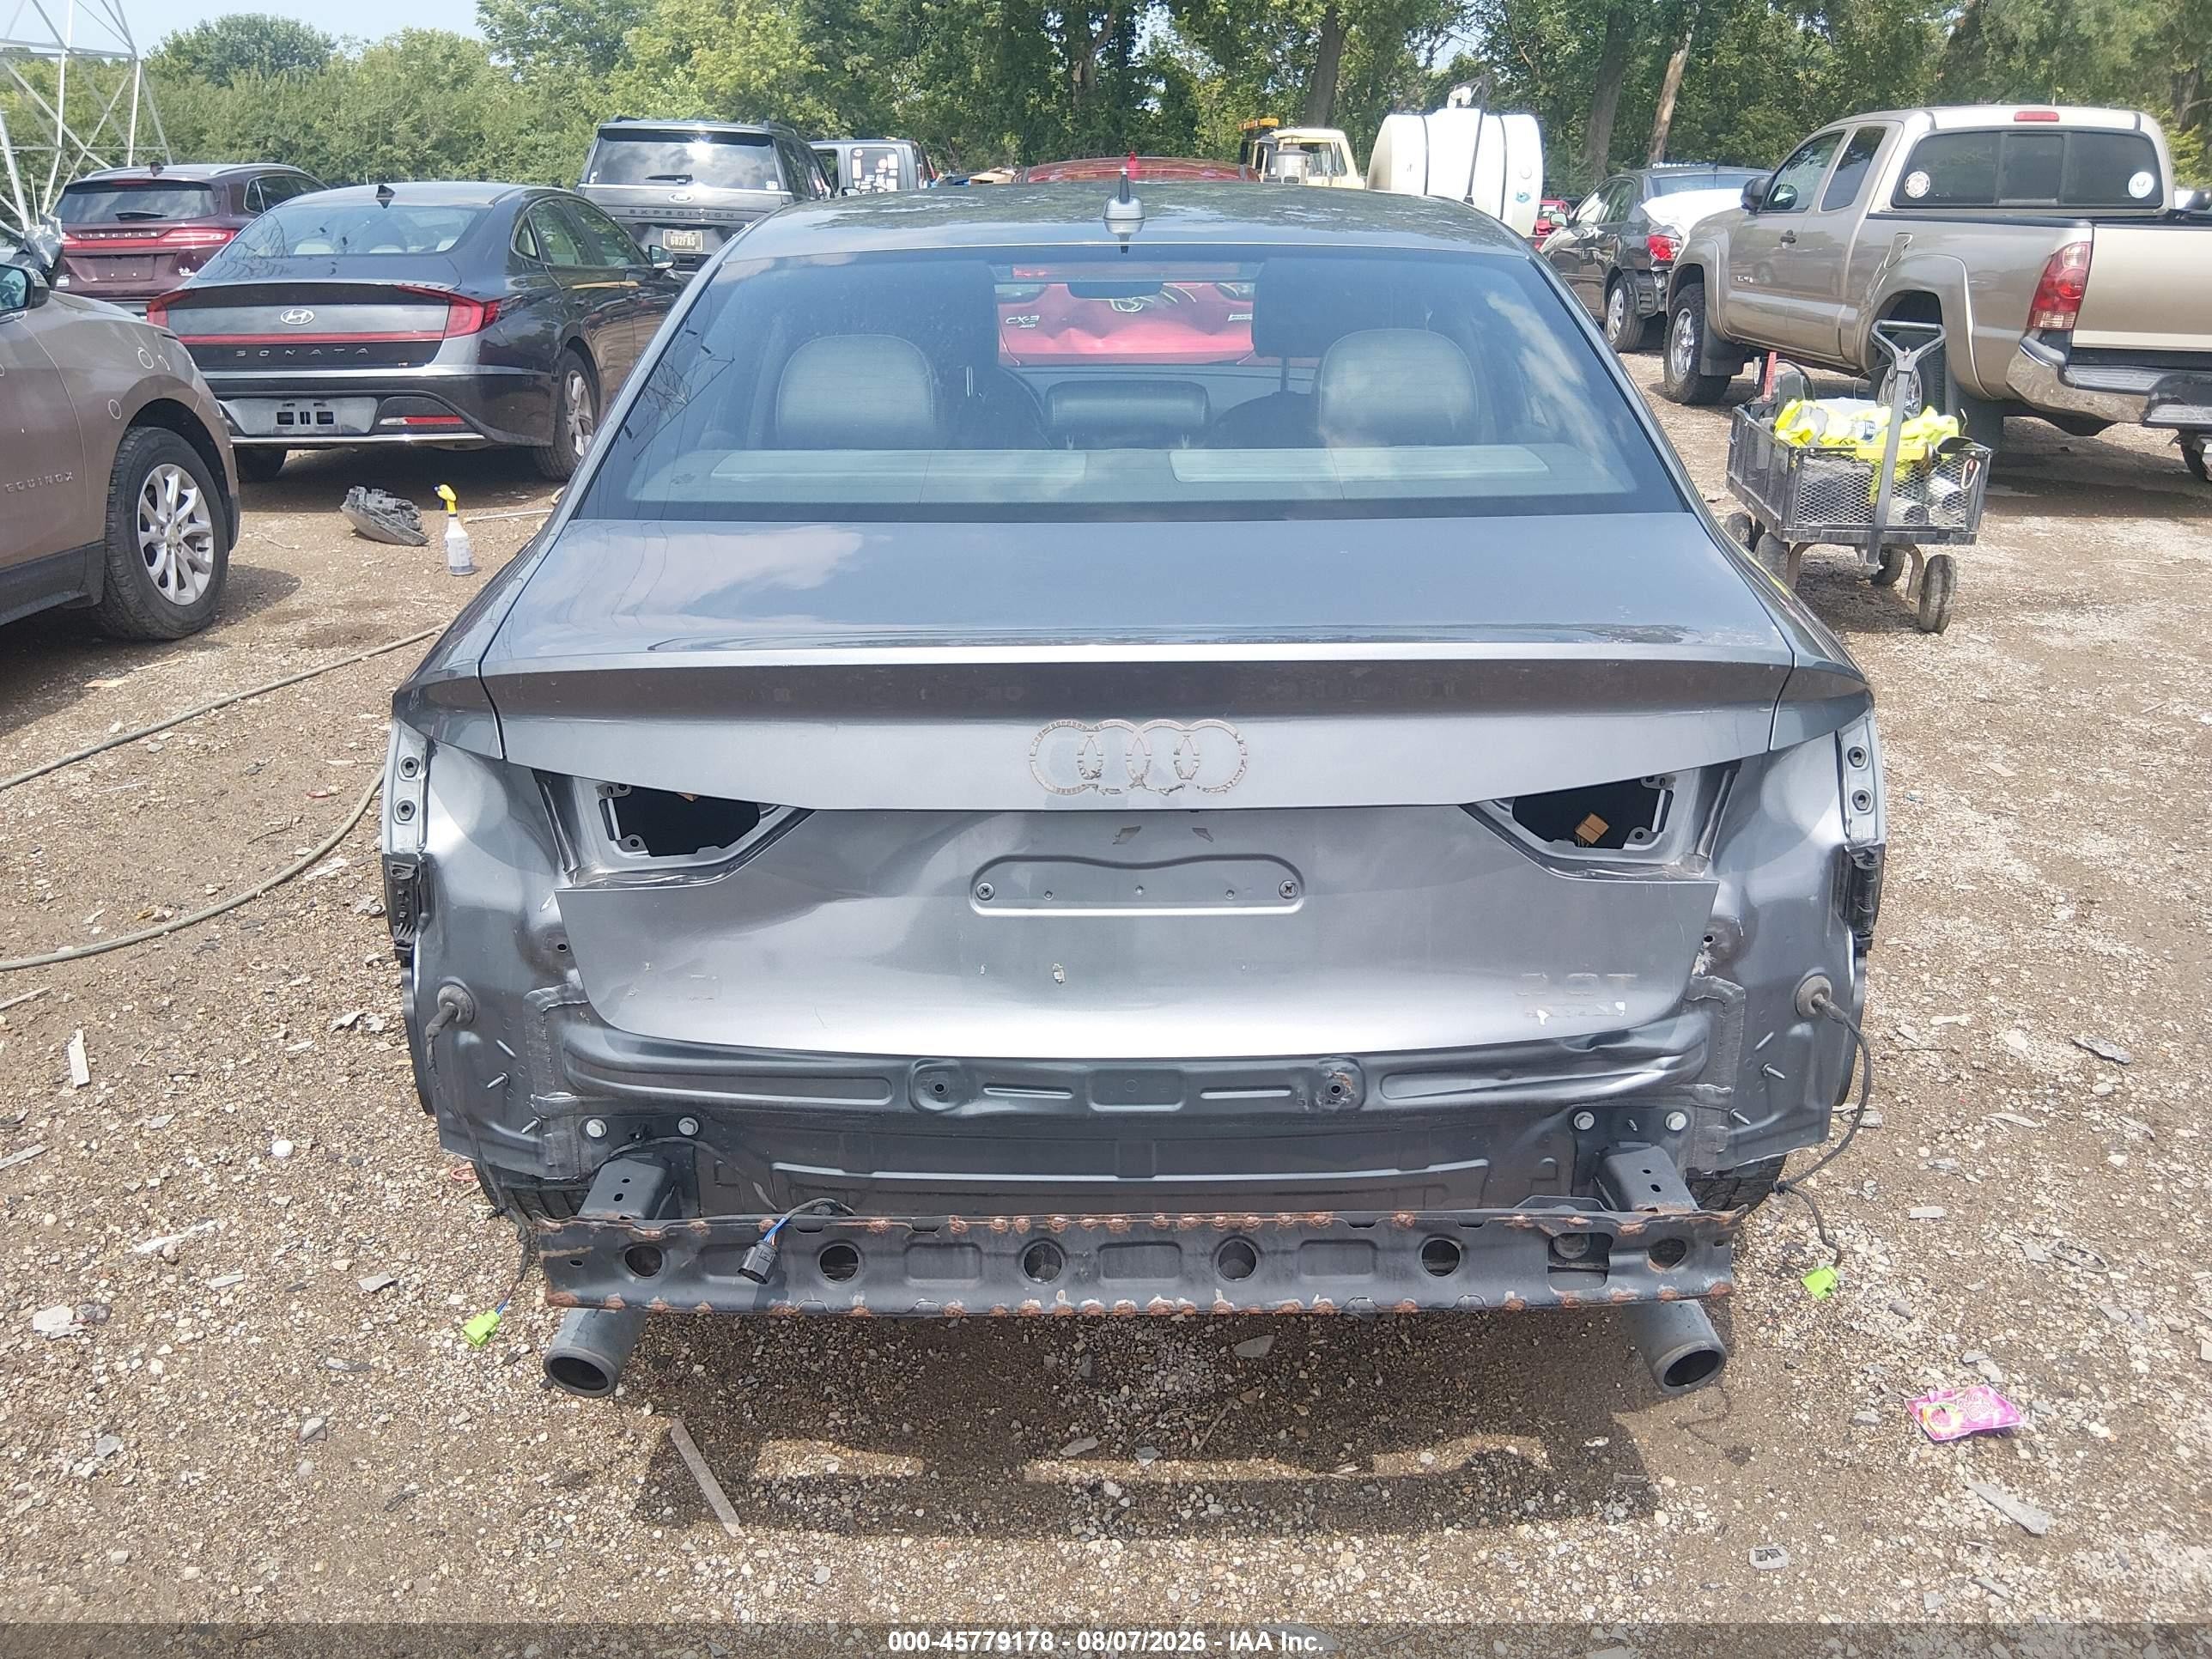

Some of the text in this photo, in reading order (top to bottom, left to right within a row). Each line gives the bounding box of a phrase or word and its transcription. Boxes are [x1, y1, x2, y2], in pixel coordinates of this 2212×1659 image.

[629, 209, 735, 218] EXPEDITION
[1005, 315, 1041, 325] CX-3
[235, 347, 369, 357] SONATA
[6, 471, 74, 492] EQUINOX
